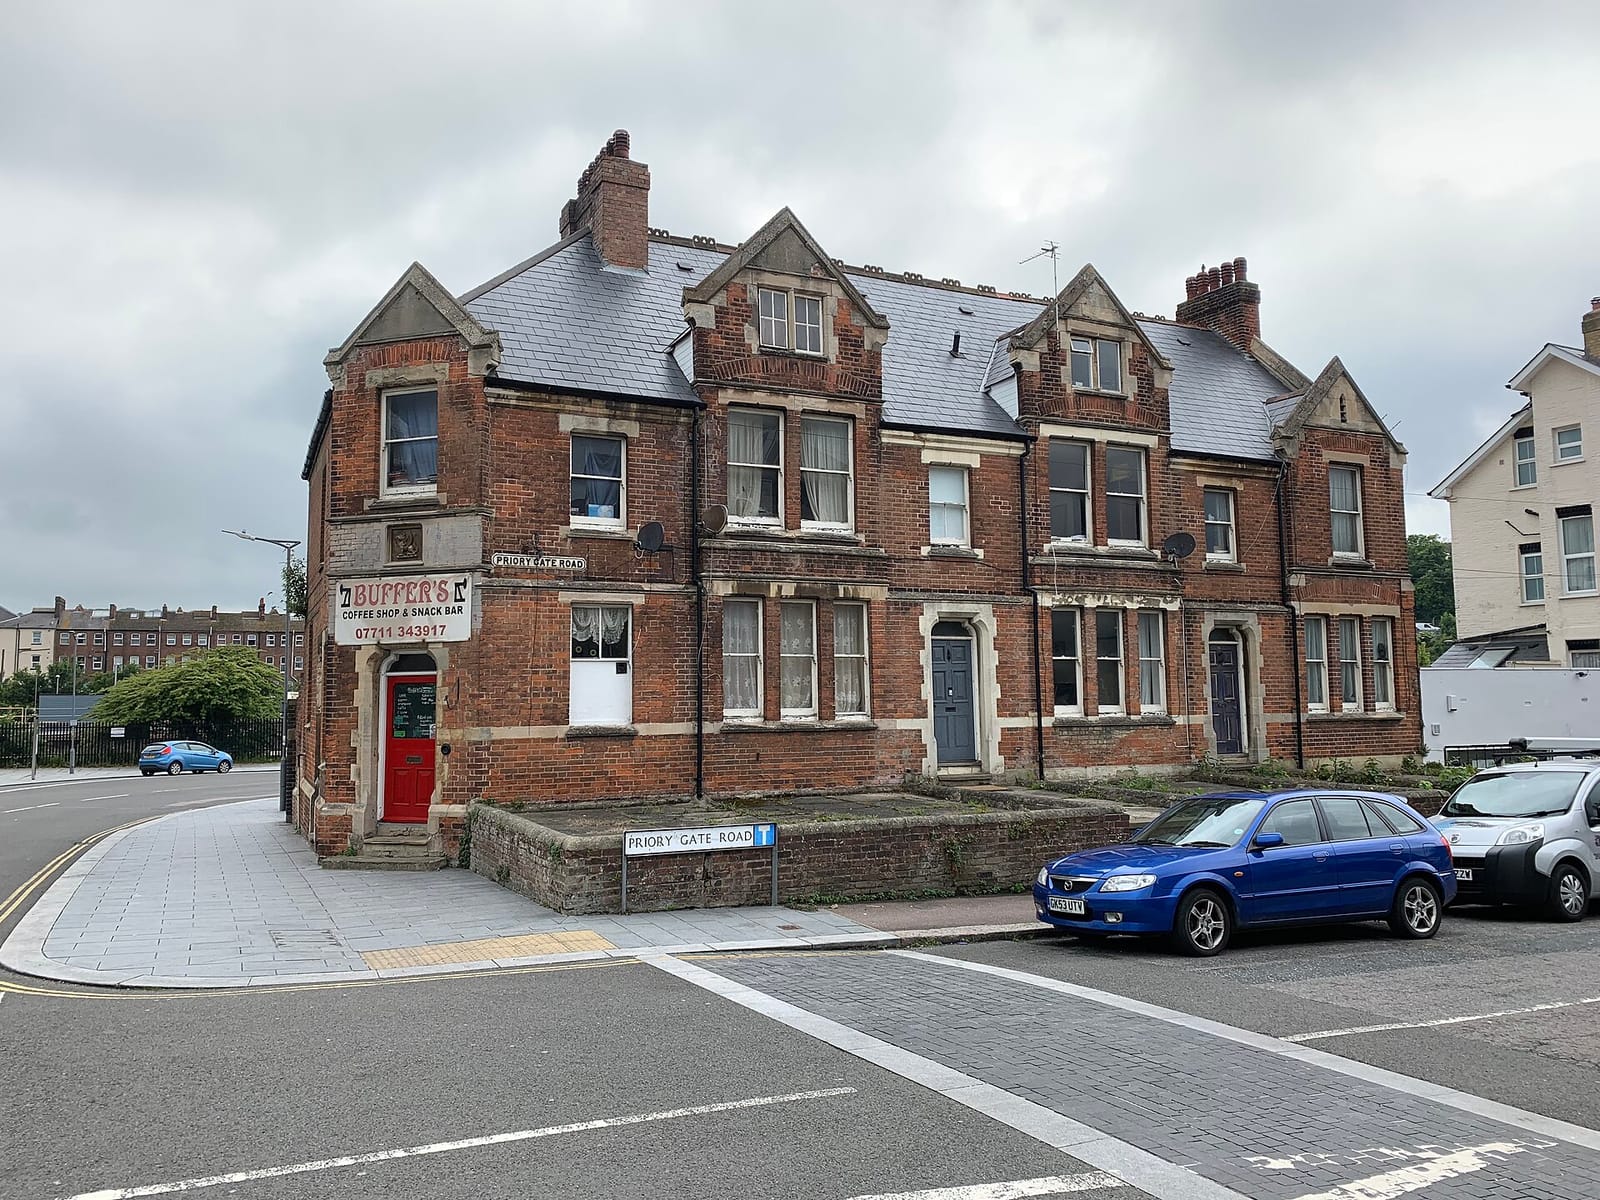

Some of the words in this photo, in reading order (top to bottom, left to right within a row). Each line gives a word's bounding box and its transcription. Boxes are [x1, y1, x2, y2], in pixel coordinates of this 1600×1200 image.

[496, 556, 532, 566] PRIORY
[533, 558, 557, 567] GATE
[559, 559, 583, 568] ROAD
[353, 579, 449, 607] BUFFER'S
[342, 610, 374, 620] COFFEE
[376, 608, 400, 618] SHOP
[402, 608, 409, 617] &
[411, 607, 442, 617] SNACK
[444, 605, 463, 615] BAR
[355, 627, 392, 639] 07711
[397, 624, 446, 637] 343917
[628, 835, 673, 849] PRIORY
[680, 833, 712, 846] GATE
[719, 830, 752, 843] ROAD
